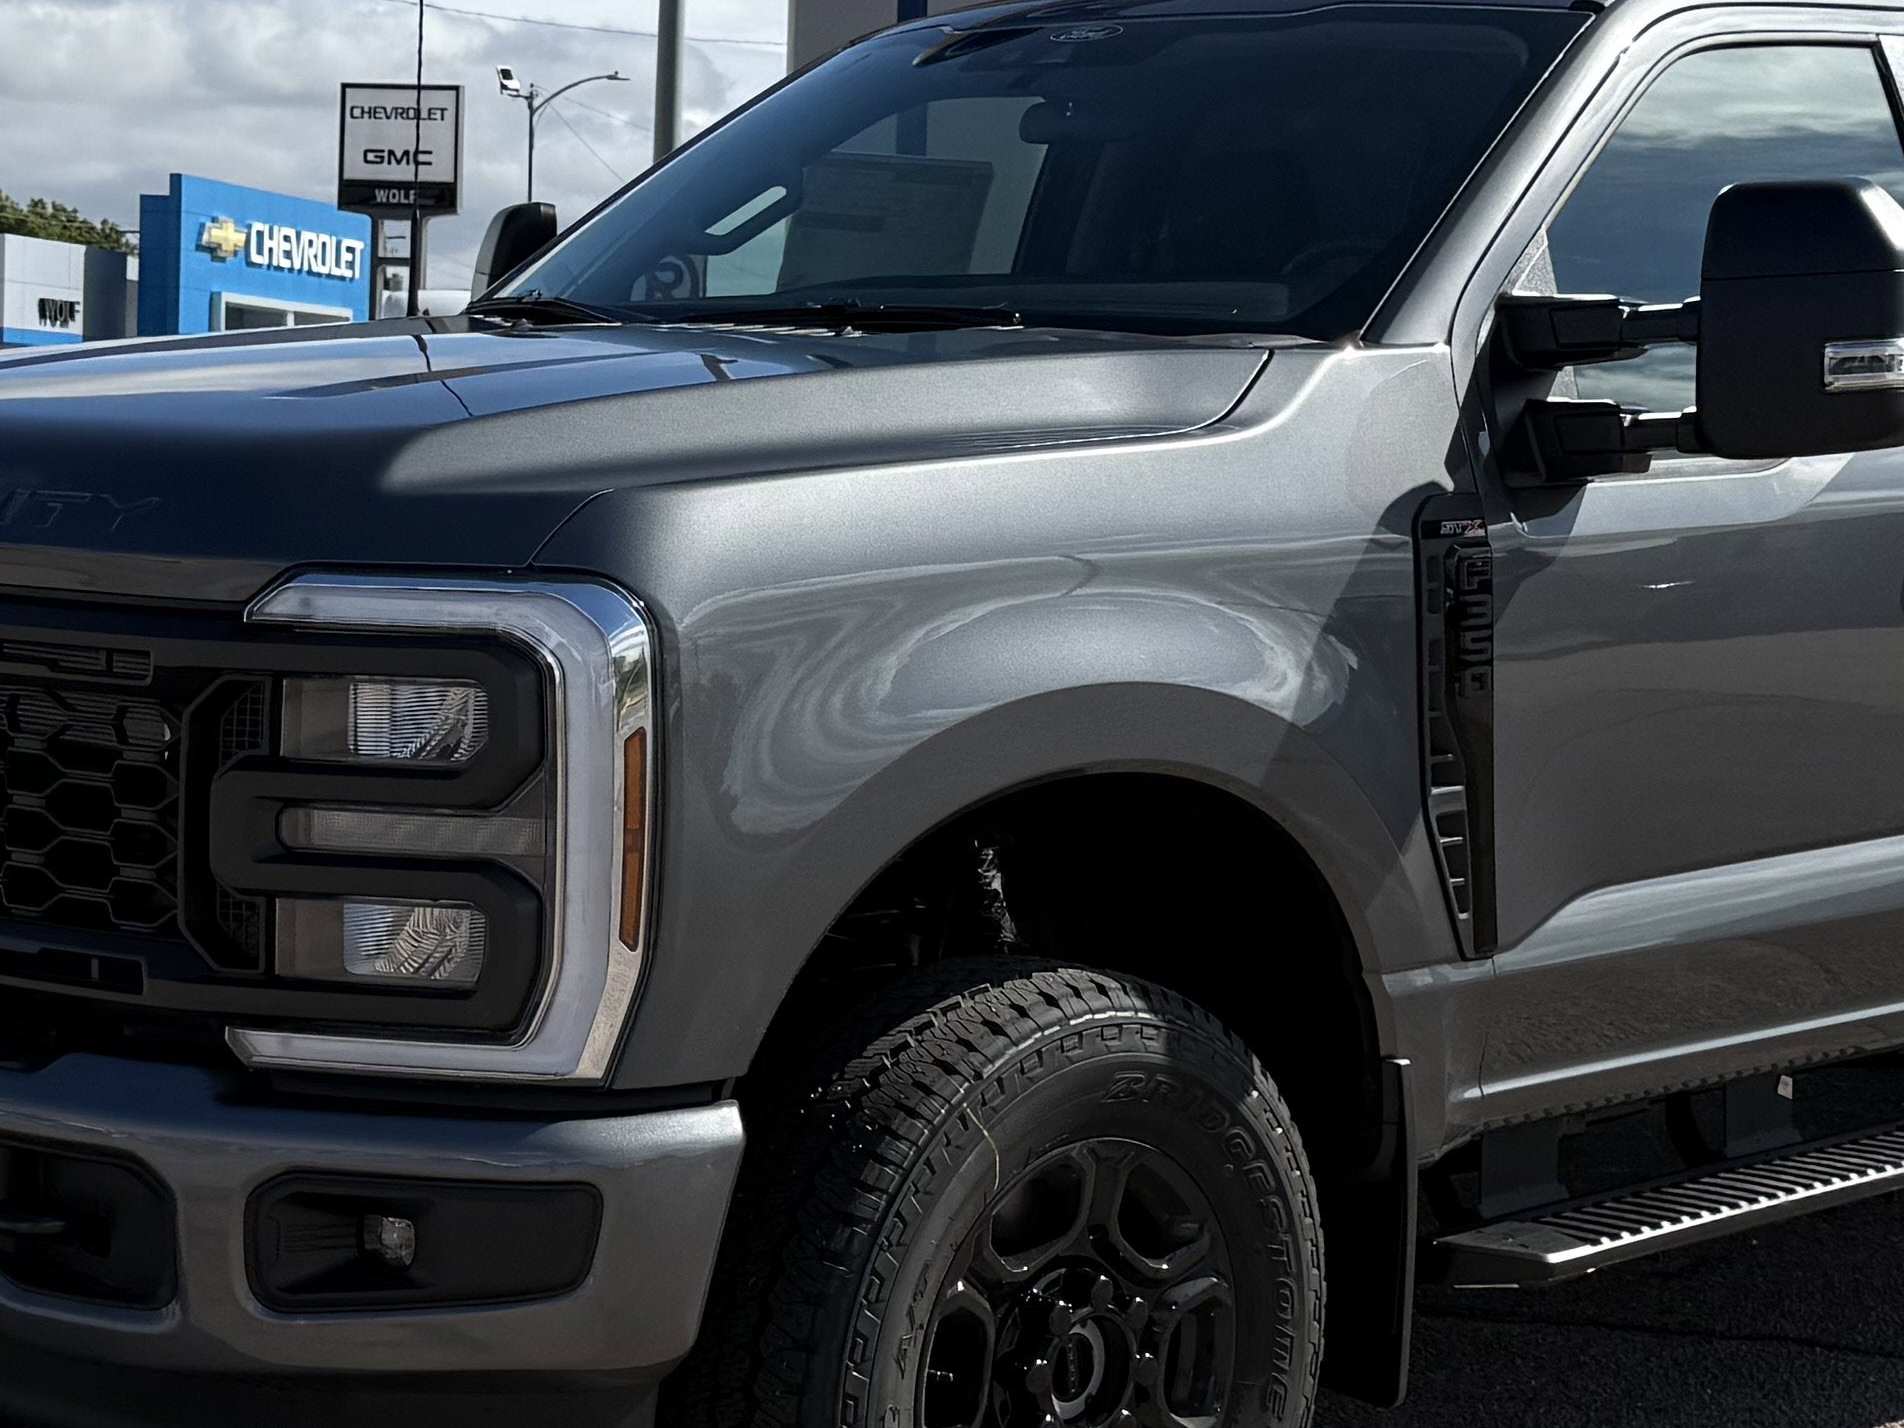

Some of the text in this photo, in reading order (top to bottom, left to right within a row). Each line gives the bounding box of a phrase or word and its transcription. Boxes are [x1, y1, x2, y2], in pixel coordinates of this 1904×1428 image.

[349, 105, 449, 122] CHEVROLET
[363, 148, 434, 166] GMC
[374, 188, 418, 205] WOLF
[250, 221, 365, 280] CHEVROLET
[1100, 1070, 1294, 1422] BRIDGESTONE
